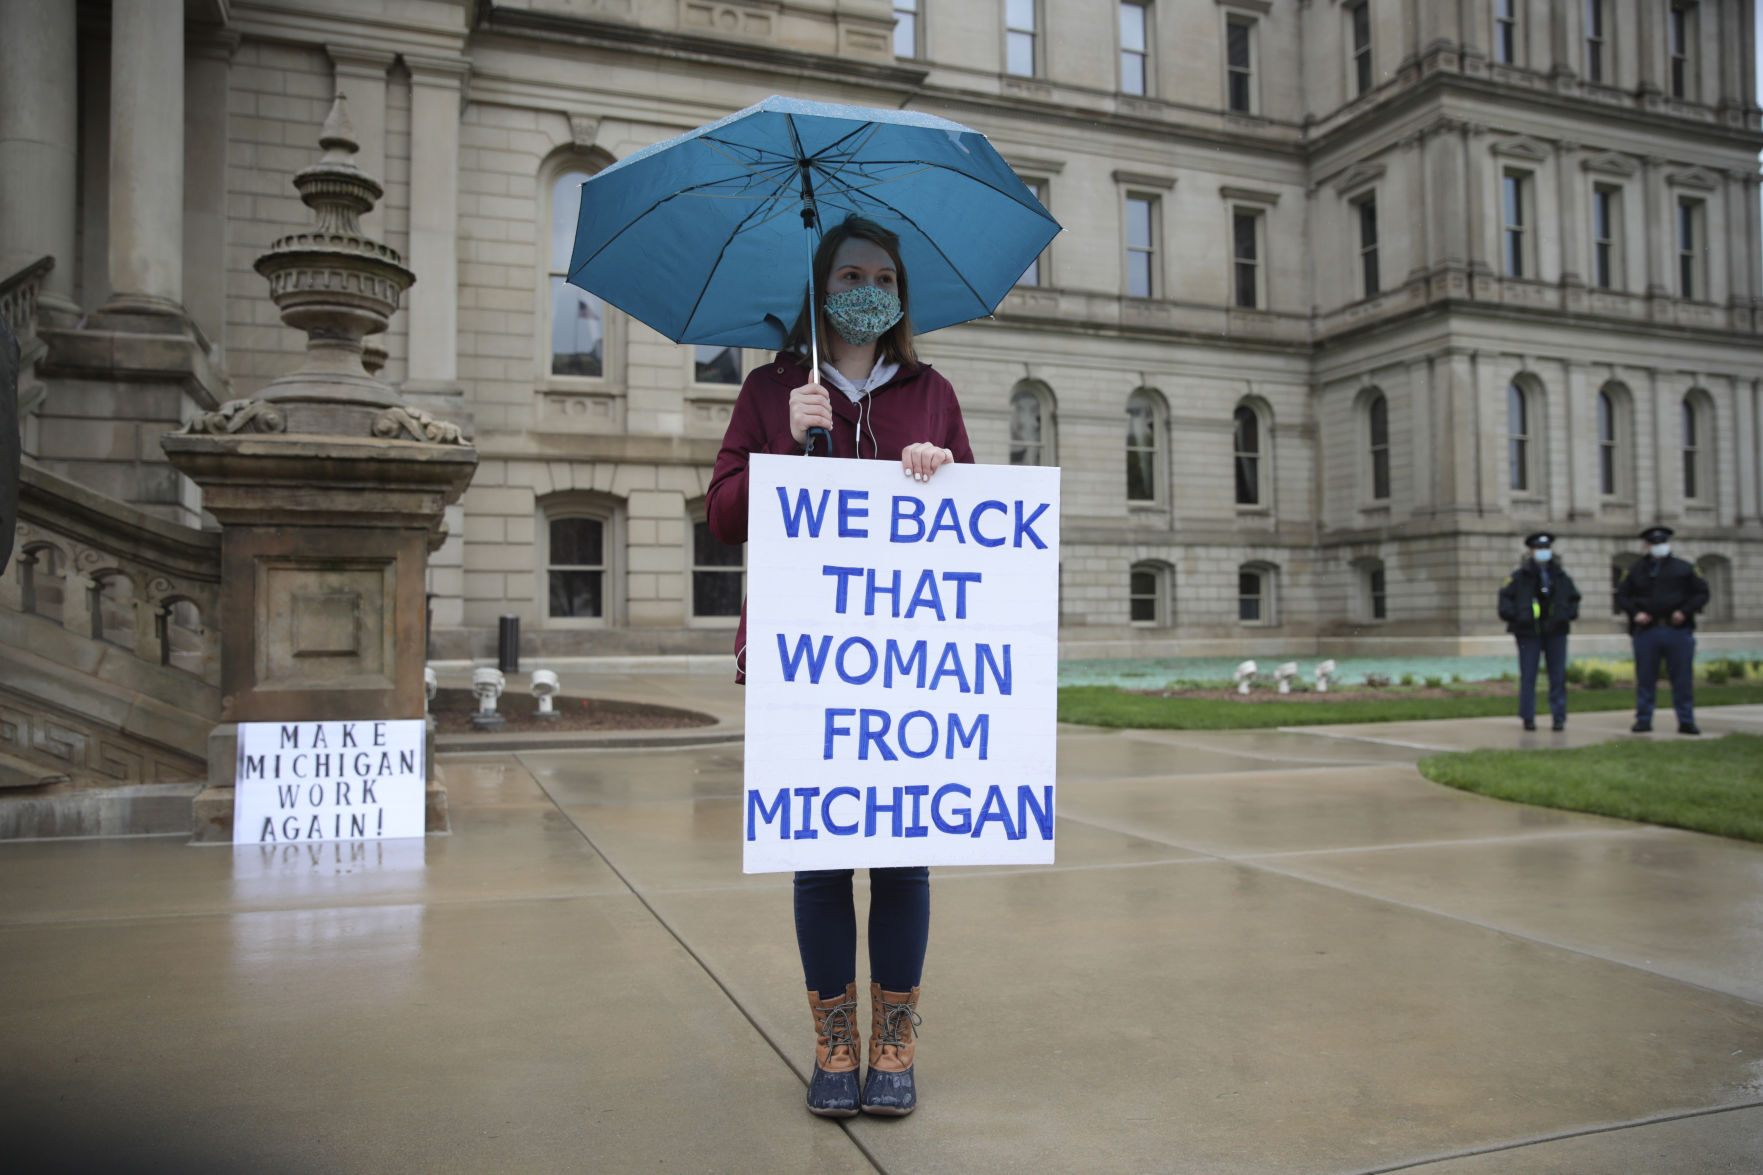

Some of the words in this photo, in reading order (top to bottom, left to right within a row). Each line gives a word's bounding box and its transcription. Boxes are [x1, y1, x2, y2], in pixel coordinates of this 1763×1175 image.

[776, 486, 869, 538] WE
[890, 495, 1051, 549] BACK
[822, 565, 982, 621] THAT
[776, 634, 1012, 695] WOMAN
[280, 722, 386, 749] MAKE
[824, 708, 989, 761] FROM
[246, 750, 414, 779] MICHIGAN
[278, 780, 377, 808] WORK
[747, 783, 1053, 841] MICHIGAN
[260, 808, 383, 842] AGAIN!
